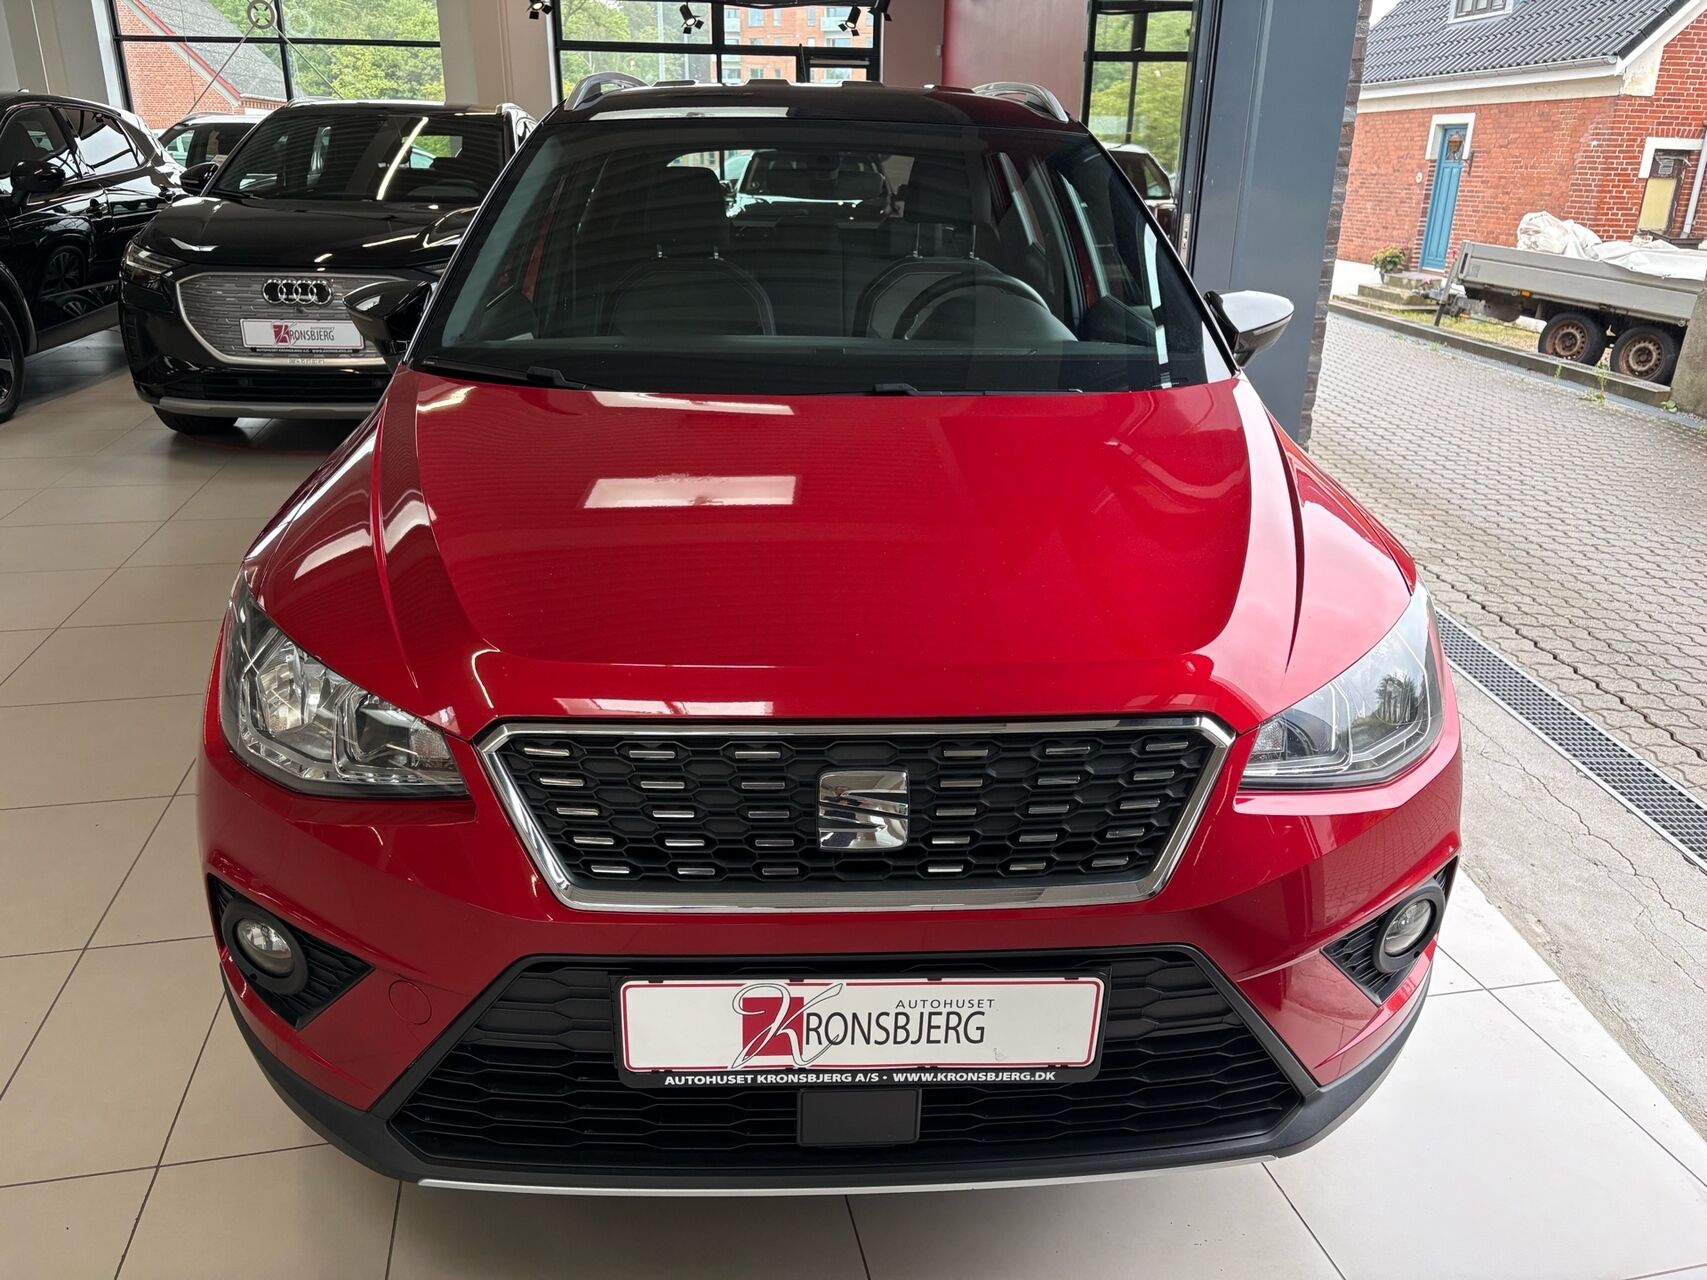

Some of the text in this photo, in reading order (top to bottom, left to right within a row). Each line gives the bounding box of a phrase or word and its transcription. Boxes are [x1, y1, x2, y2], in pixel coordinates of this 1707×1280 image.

[895, 998, 996, 1009] AUTOHUSET
[731, 983, 986, 1069] KRONSBJERG
[664, 1071, 1057, 1086] AUTOHUSET KRONSBJERG A/S WWW.KRONSBJERG.DK
